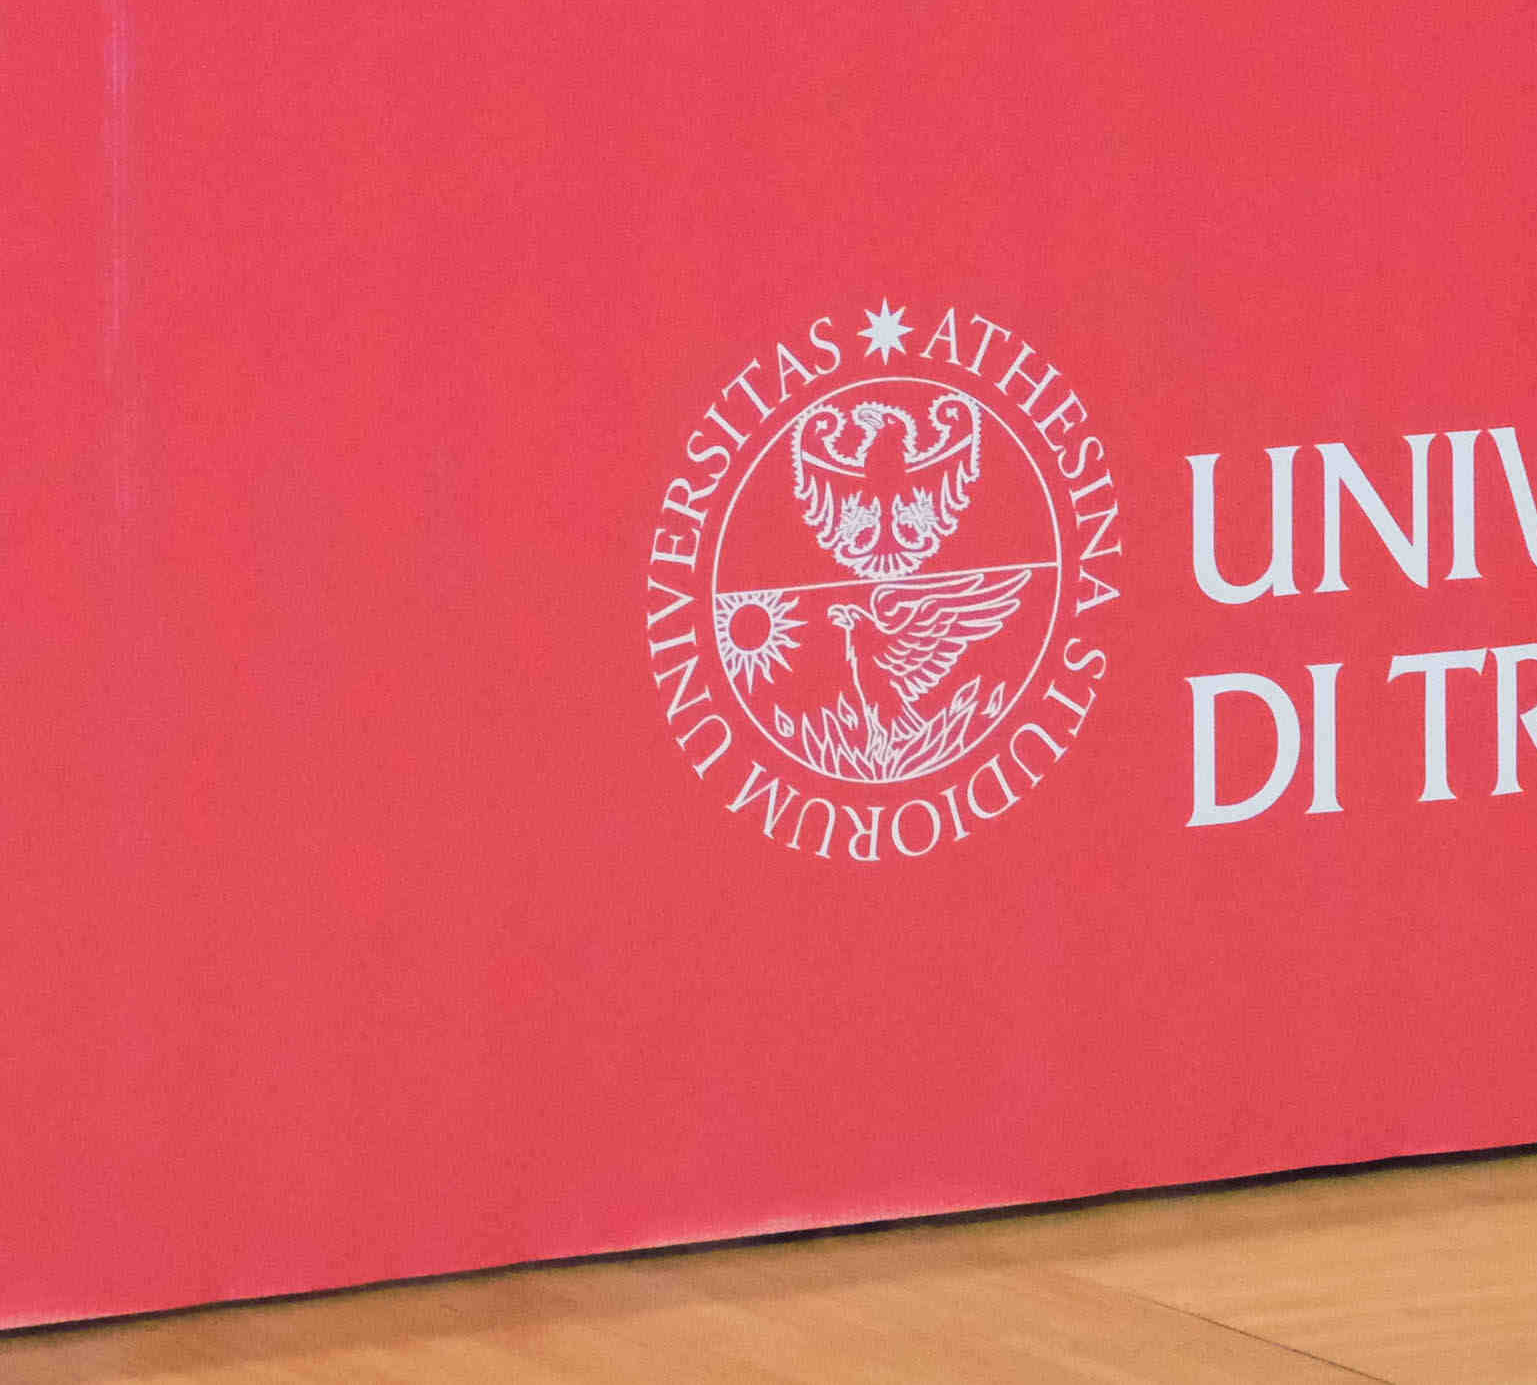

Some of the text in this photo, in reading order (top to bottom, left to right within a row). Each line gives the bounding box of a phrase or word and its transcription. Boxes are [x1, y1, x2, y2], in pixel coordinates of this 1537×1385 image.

[646, 306, 1123, 863] ATHESINA STUDIORUM UNIVERSITAS
[1184, 662, 1346, 828] DI
